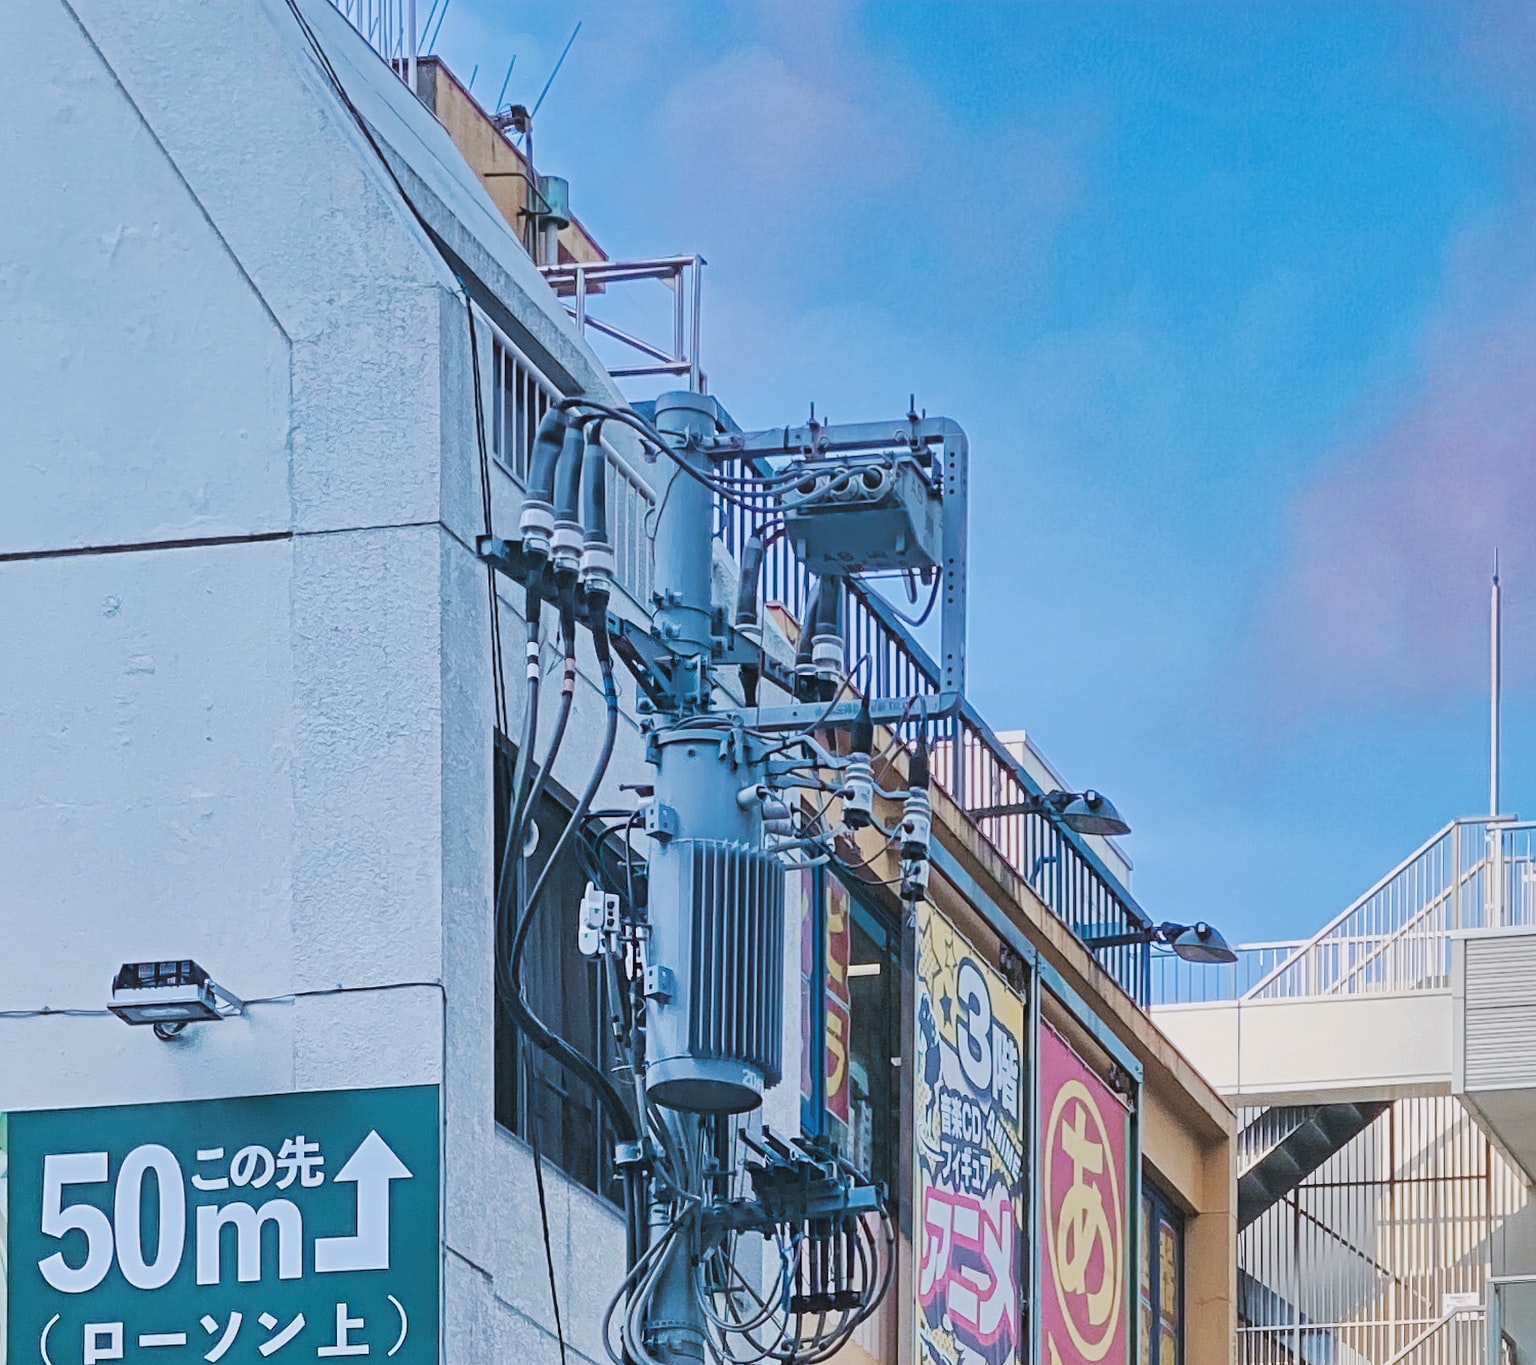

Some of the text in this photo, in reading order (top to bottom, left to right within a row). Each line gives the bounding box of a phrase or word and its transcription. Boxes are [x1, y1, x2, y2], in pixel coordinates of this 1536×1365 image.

[191, 1136, 325, 1192] この先
[985, 1110, 1024, 1183] ANIME
[38, 1143, 303, 1294] 50m
[920, 1197, 1016, 1336] アニメ
